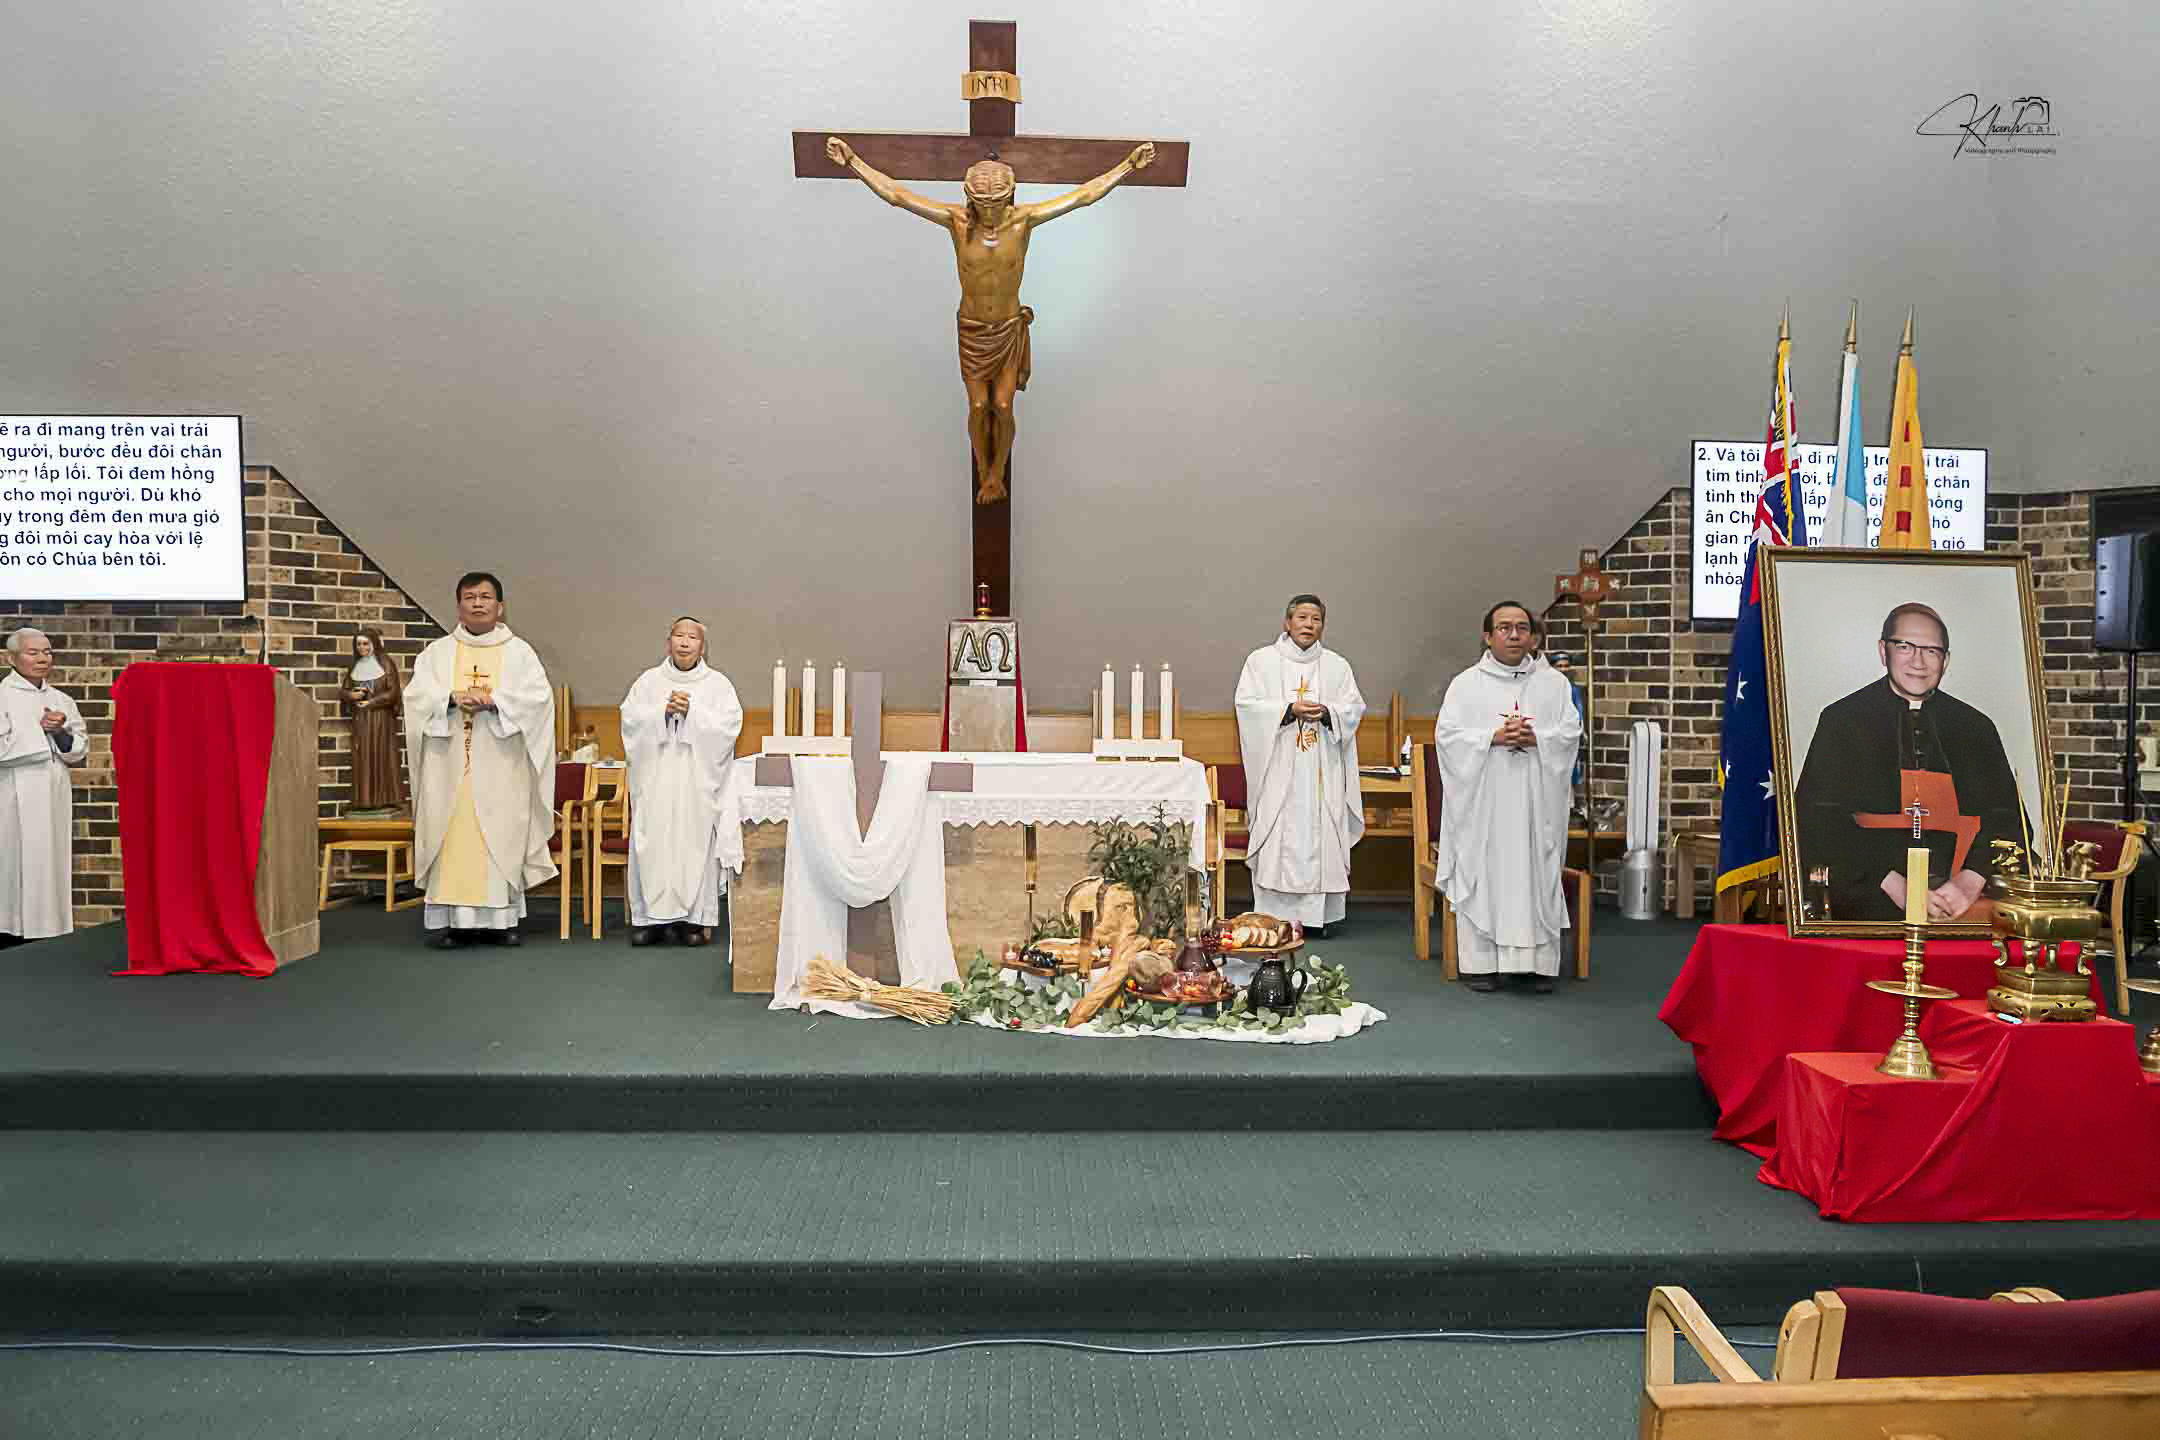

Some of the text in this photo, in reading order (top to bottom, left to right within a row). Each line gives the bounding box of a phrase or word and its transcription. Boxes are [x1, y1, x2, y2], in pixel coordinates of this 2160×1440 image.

[971, 78, 1009, 92] INRI
[15, 426, 30, 436] ra
[37, 422, 52, 436] đi
[58, 426, 105, 440] mang
[112, 422, 144, 436] trên
[151, 422, 175, 437] vai
[181, 422, 208, 437] trái
[59, 443, 105, 458] bước
[112, 441, 141, 458] đều
[148, 444, 174, 458] đôi
[181, 443, 222, 458] chân
[1698, 447, 1711, 461] 2.
[1716, 447, 1736, 462] Và
[1741, 448, 1760, 462] tôi
[1808, 452, 1821, 465] đi
[34, 462, 60, 483] lấp
[66, 462, 91, 480] lối.
[96, 465, 123, 480] Tôi
[129, 466, 165, 480] đem
[171, 463, 214, 484] hồng
[1706, 469, 1730, 482] tim
[1934, 475, 1970, 489] chân
[3, 487, 201, 505] cho mọi người. Dù khó
[1804, 489, 1827, 508] lấp
[18, 510, 64, 526] trong
[69, 509, 106, 523] đêm
[112, 509, 143, 523] đen
[149, 512, 187, 523] mưa
[193, 509, 220, 527] gió
[1705, 510, 1724, 523] ân
[14, 530, 41, 544] đôi
[47, 530, 78, 544] môi
[83, 534, 113, 548] cay
[156, 531, 183, 544] với
[189, 531, 203, 549] lệ
[1705, 531, 1738, 547] gian
[26, 551, 47, 565] có
[52, 551, 97, 565] Chúa
[102, 551, 134, 566] bên
[139, 551, 166, 566] tôi.
[1705, 551, 1738, 568] lạnh
